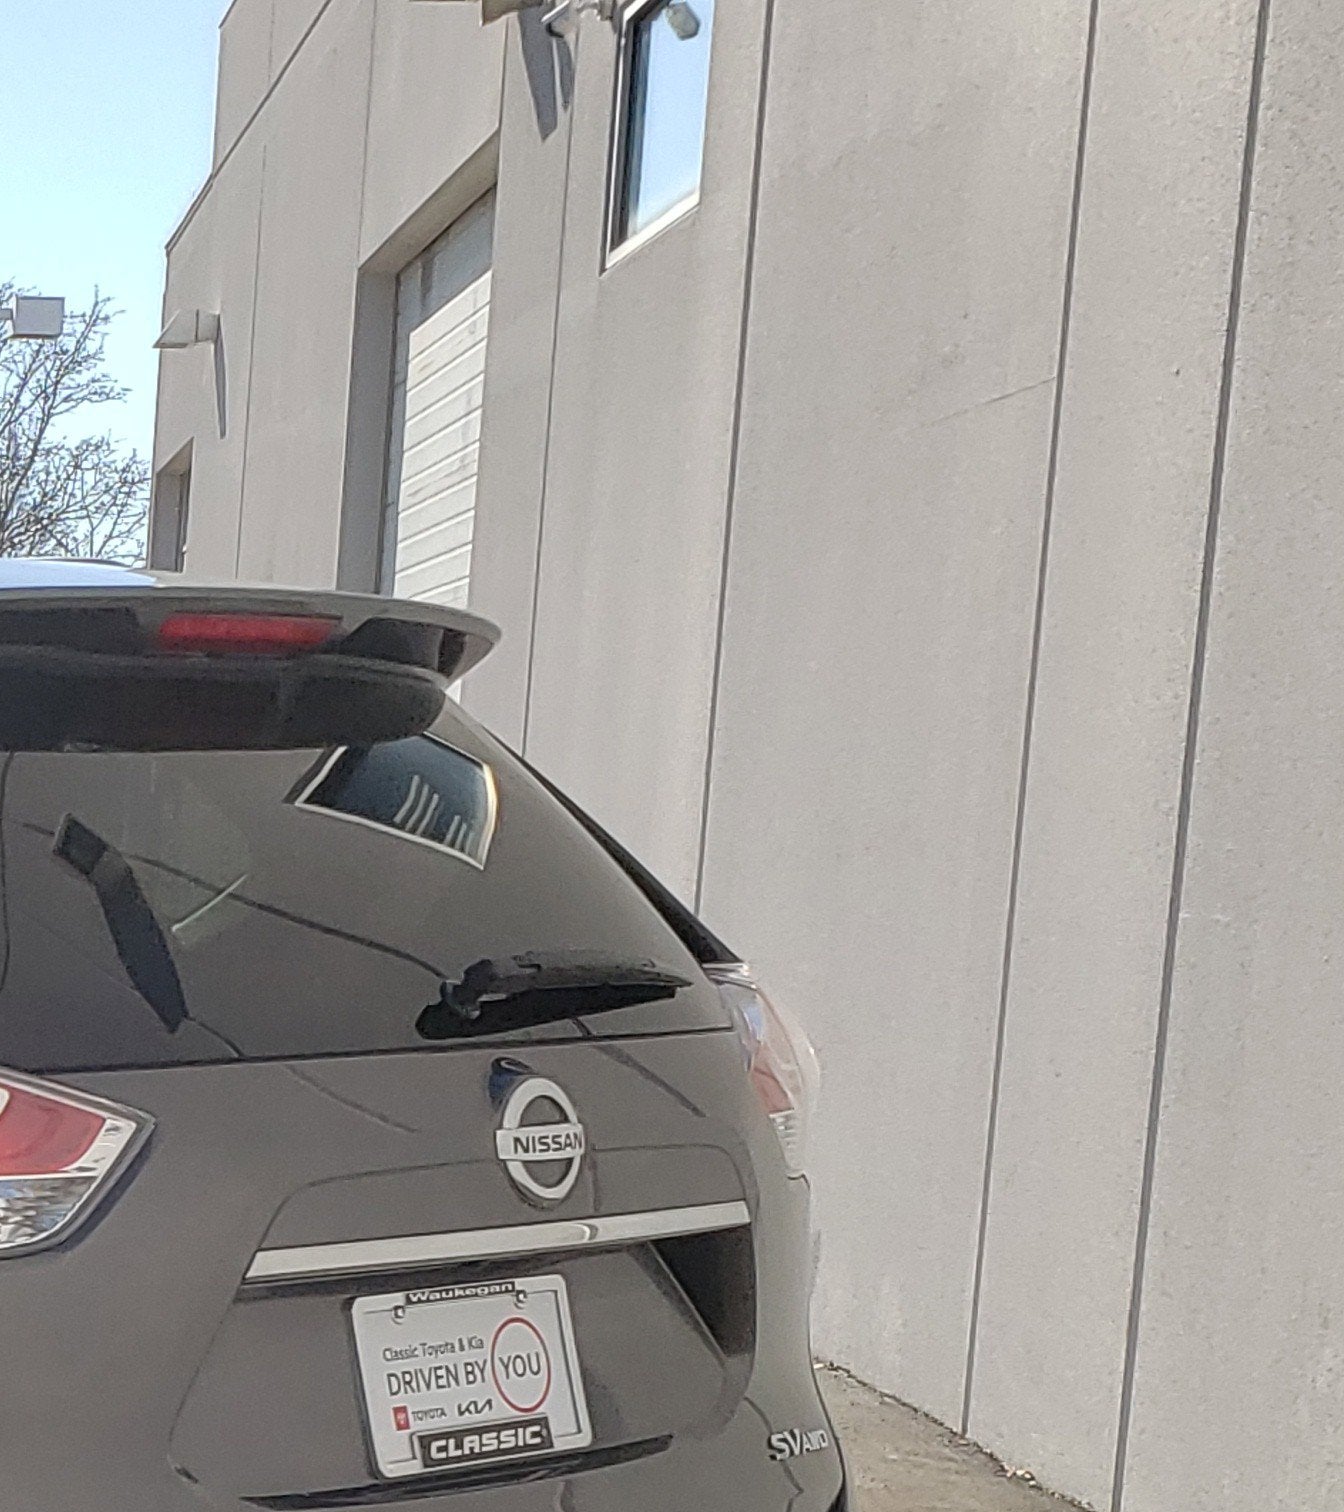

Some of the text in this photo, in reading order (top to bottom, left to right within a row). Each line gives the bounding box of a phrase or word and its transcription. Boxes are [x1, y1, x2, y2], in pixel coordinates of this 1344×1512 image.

[513, 1132, 583, 1154] NISSAN
[409, 1282, 513, 1302] Waukegan
[383, 1345, 419, 1361] Classic
[419, 1342, 456, 1359] Toyota
[468, 1335, 485, 1350] Kia
[387, 1352, 541, 1396] DRIVEN BY YOU
[411, 1407, 447, 1422] TOYOTA
[429, 1425, 542, 1460] CLASSIC
